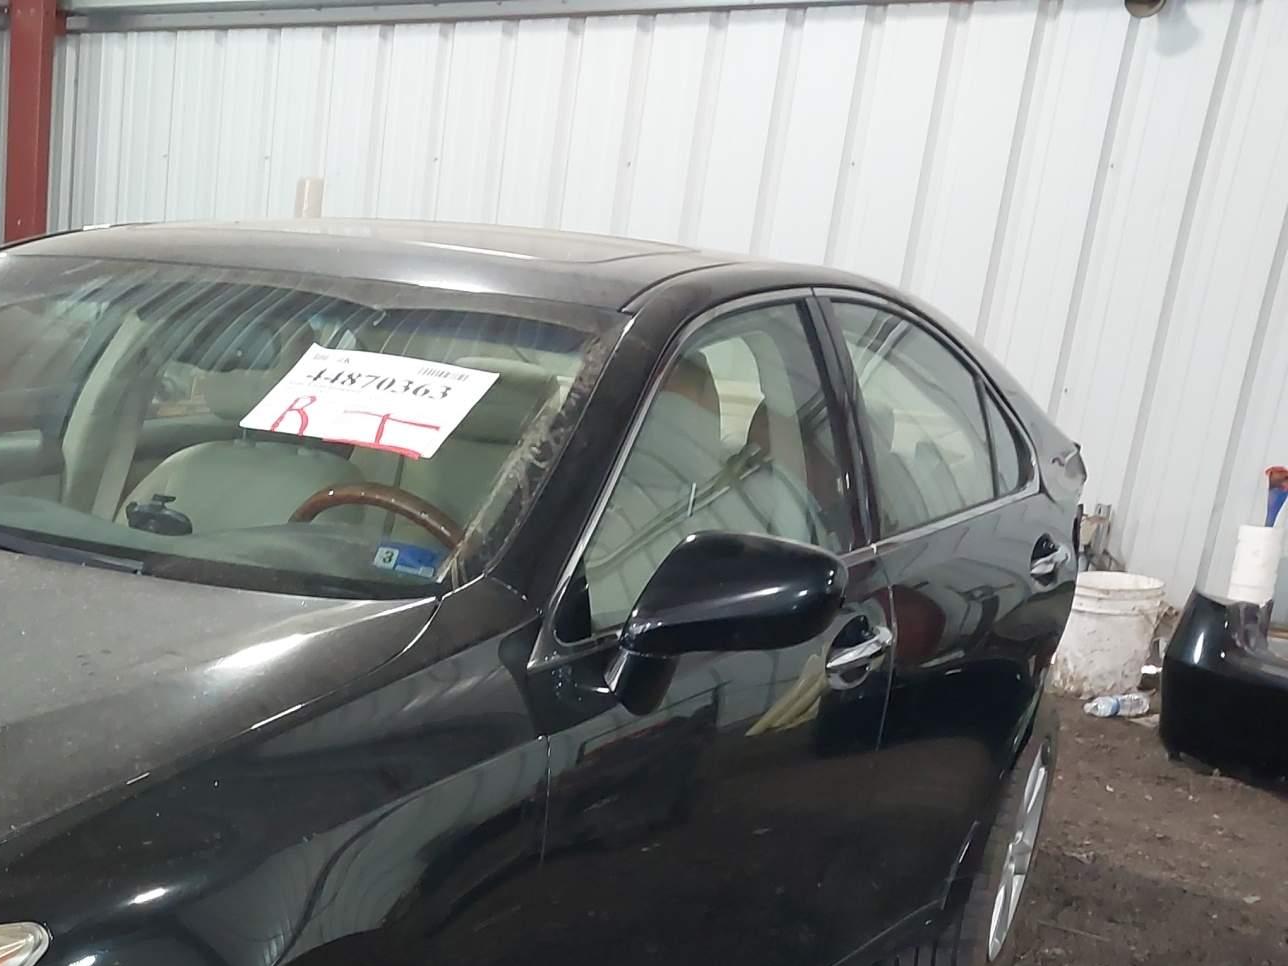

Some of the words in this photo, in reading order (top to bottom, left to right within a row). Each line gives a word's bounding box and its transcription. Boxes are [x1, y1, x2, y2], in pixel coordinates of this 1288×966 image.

[306, 367, 453, 400] 44870363
[270, 396, 317, 437] R
[382, 550, 394, 564] 3
